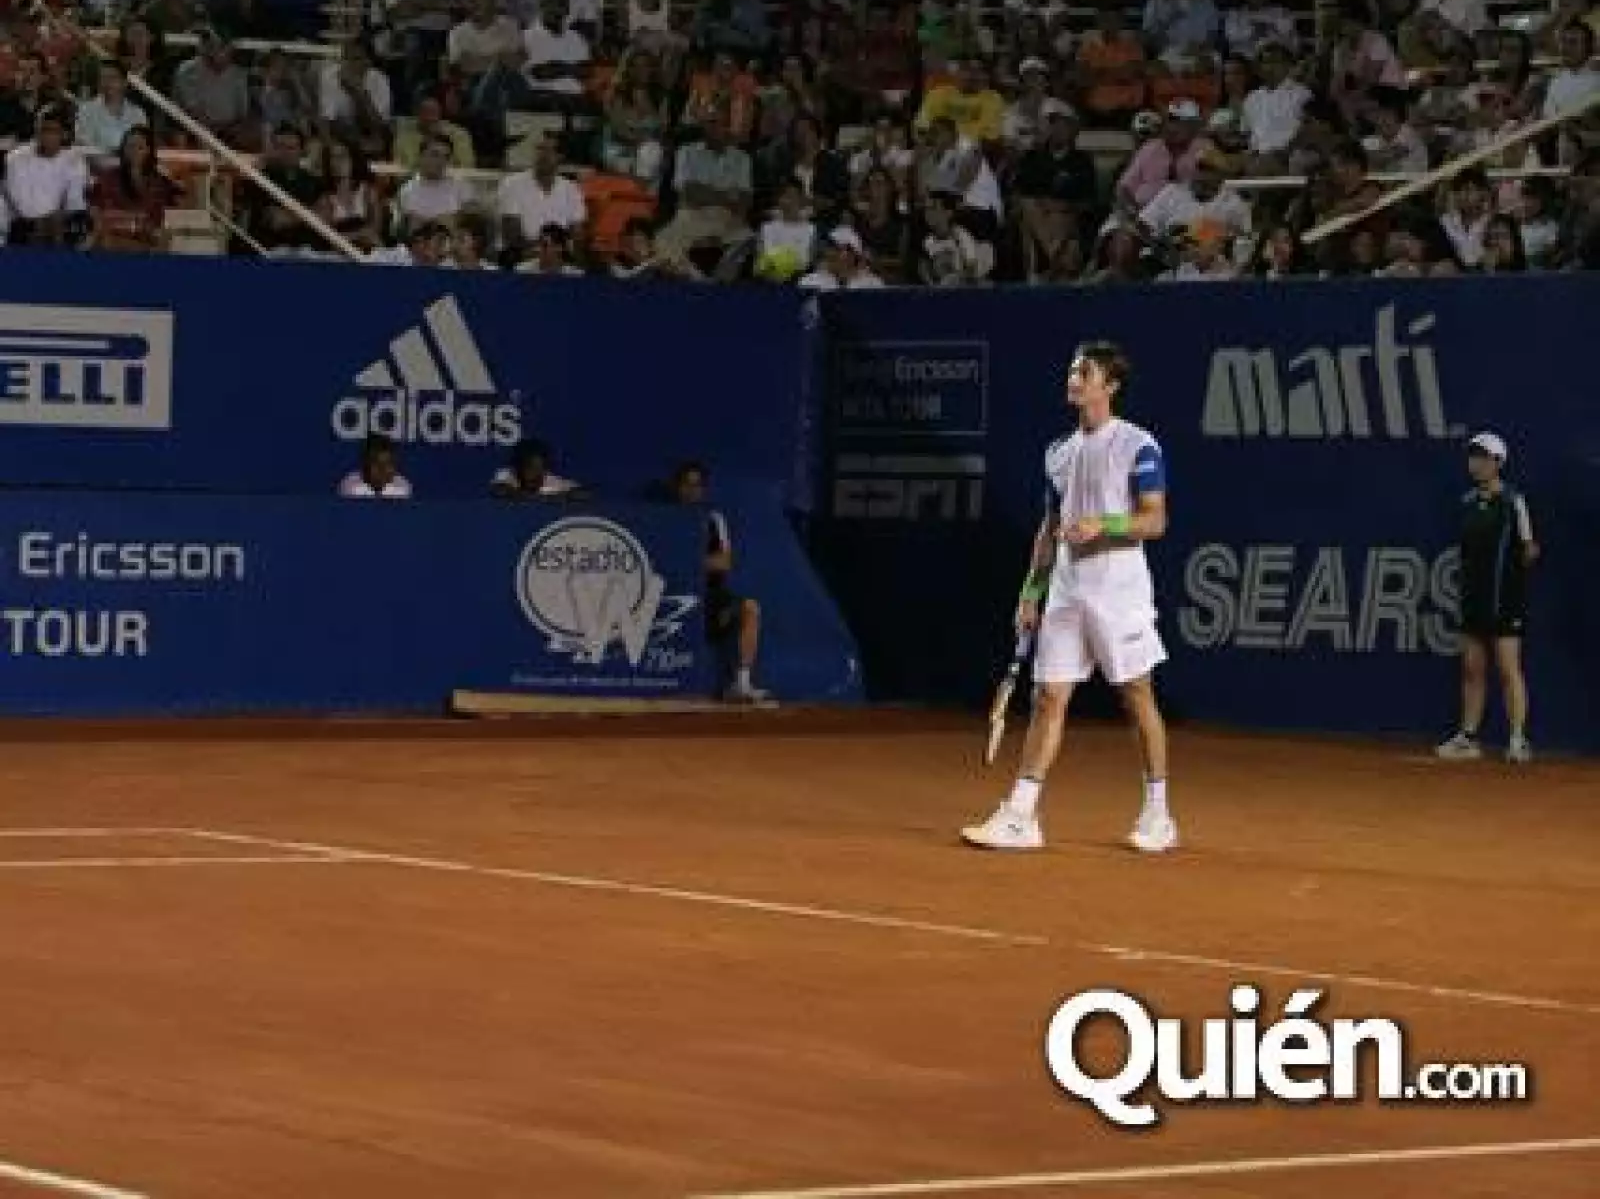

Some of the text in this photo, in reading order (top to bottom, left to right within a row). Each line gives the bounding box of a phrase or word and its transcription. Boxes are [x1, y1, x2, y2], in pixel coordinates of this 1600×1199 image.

[330, 386, 523, 446] adidas
[18, 530, 246, 582] Ericsson
[1, 608, 150, 659] TOUR
